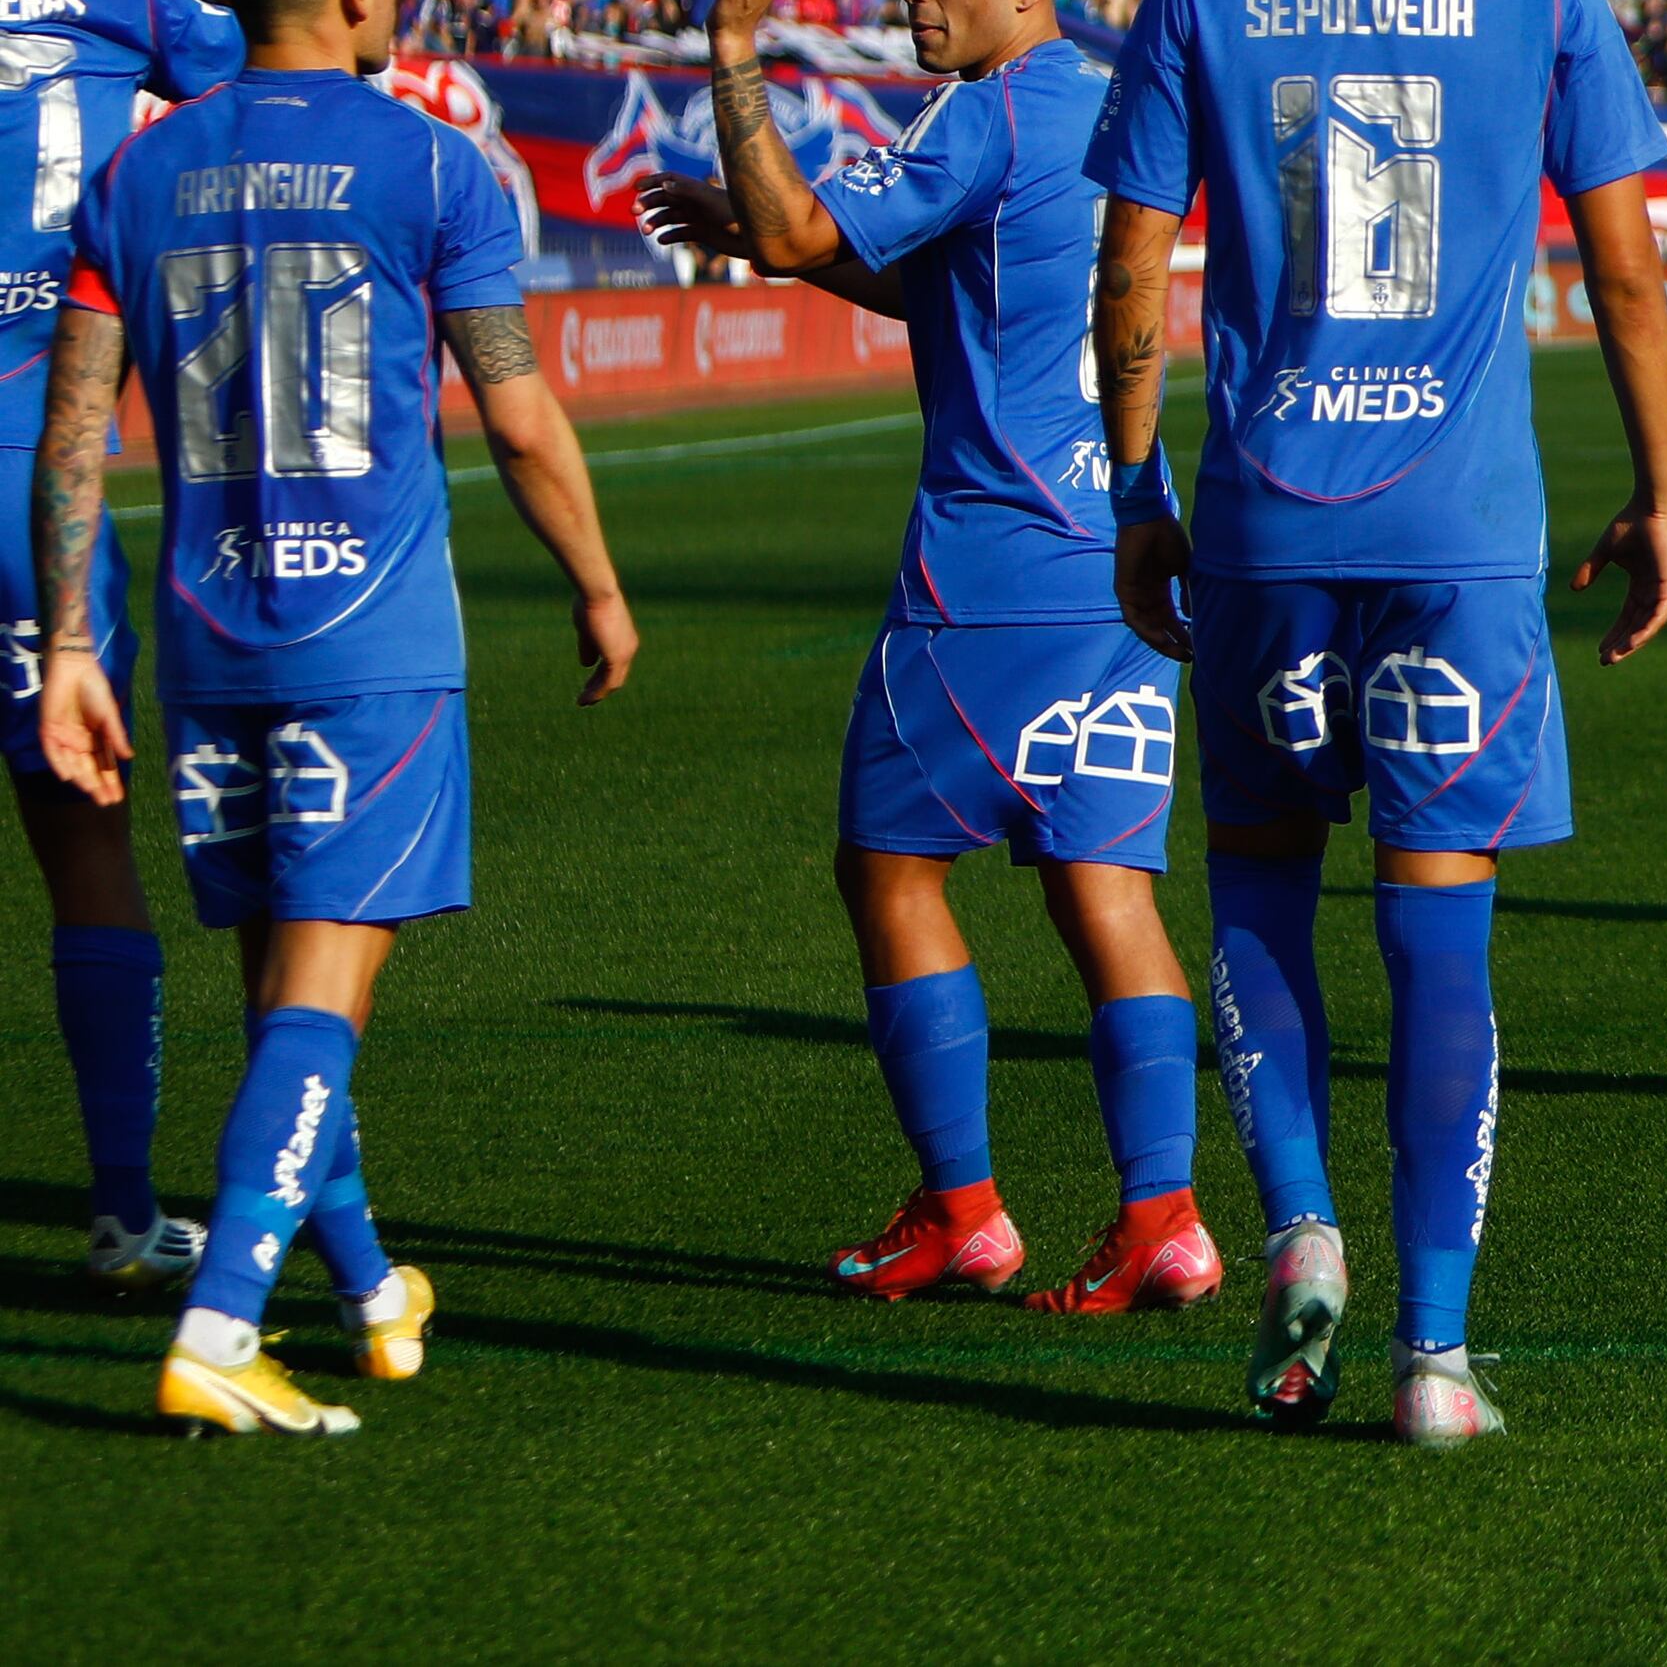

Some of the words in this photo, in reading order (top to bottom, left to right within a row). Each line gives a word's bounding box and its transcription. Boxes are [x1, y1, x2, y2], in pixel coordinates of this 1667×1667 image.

[1271, 74, 1442, 319] 16
[157, 242, 373, 484] 20
[1331, 364, 1433, 381] CLINICA
[1311, 379, 1445, 422] MEDS
[264, 521, 351, 537] LINICA
